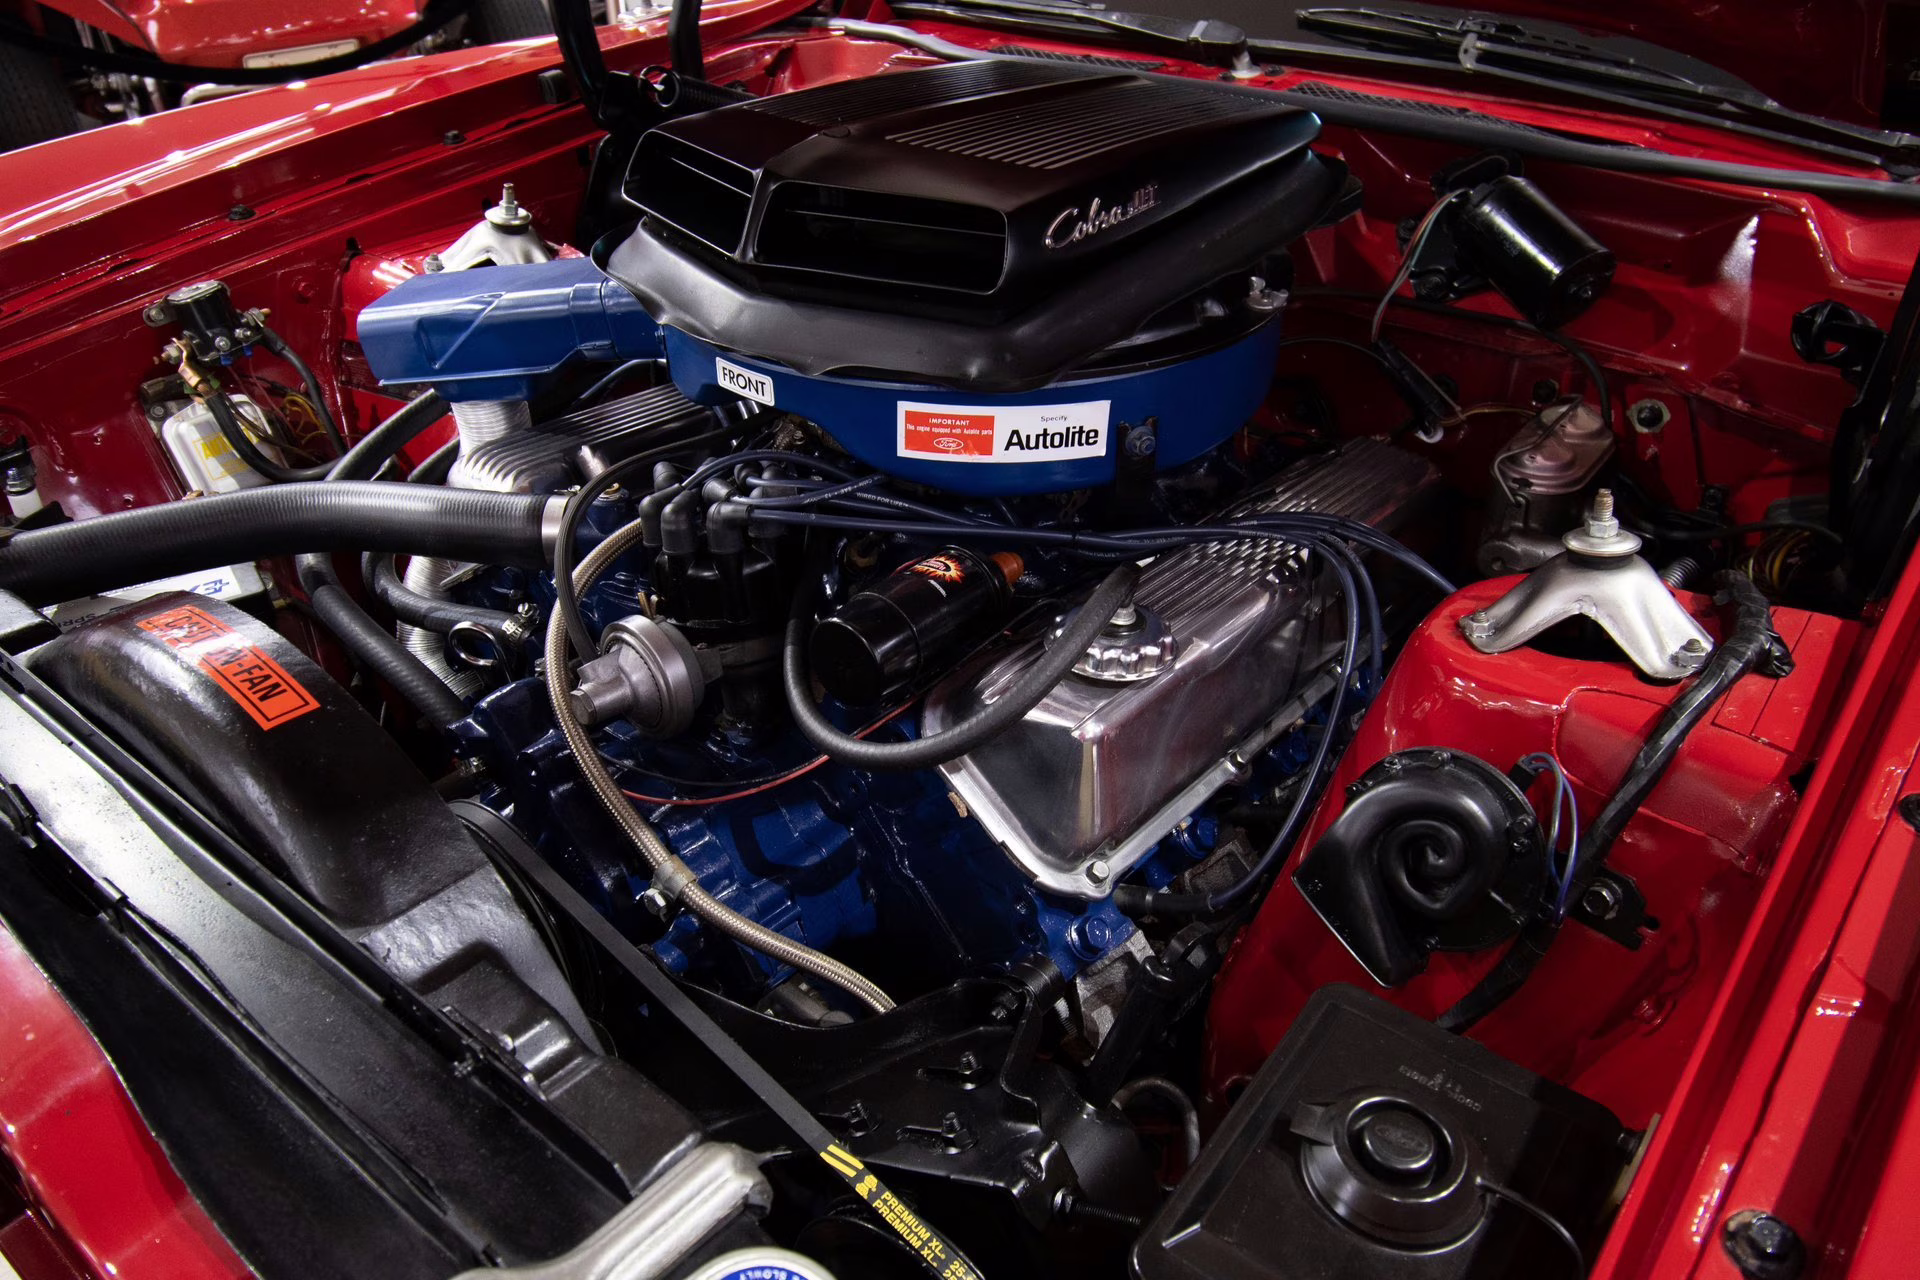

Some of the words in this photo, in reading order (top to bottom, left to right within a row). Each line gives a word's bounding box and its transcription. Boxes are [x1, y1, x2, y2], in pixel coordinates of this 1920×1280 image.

[1045, 197, 1123, 248] Cobra
[722, 367, 766, 397] FRONT
[916, 425, 931, 433] engine
[1040, 415, 1068, 423] Specify
[938, 438, 960, 448] Ford
[1003, 425, 1099, 451] Autolite
[872, 1199, 923, 1249] PREMIUM
[881, 1191, 931, 1241] PREMIUM
